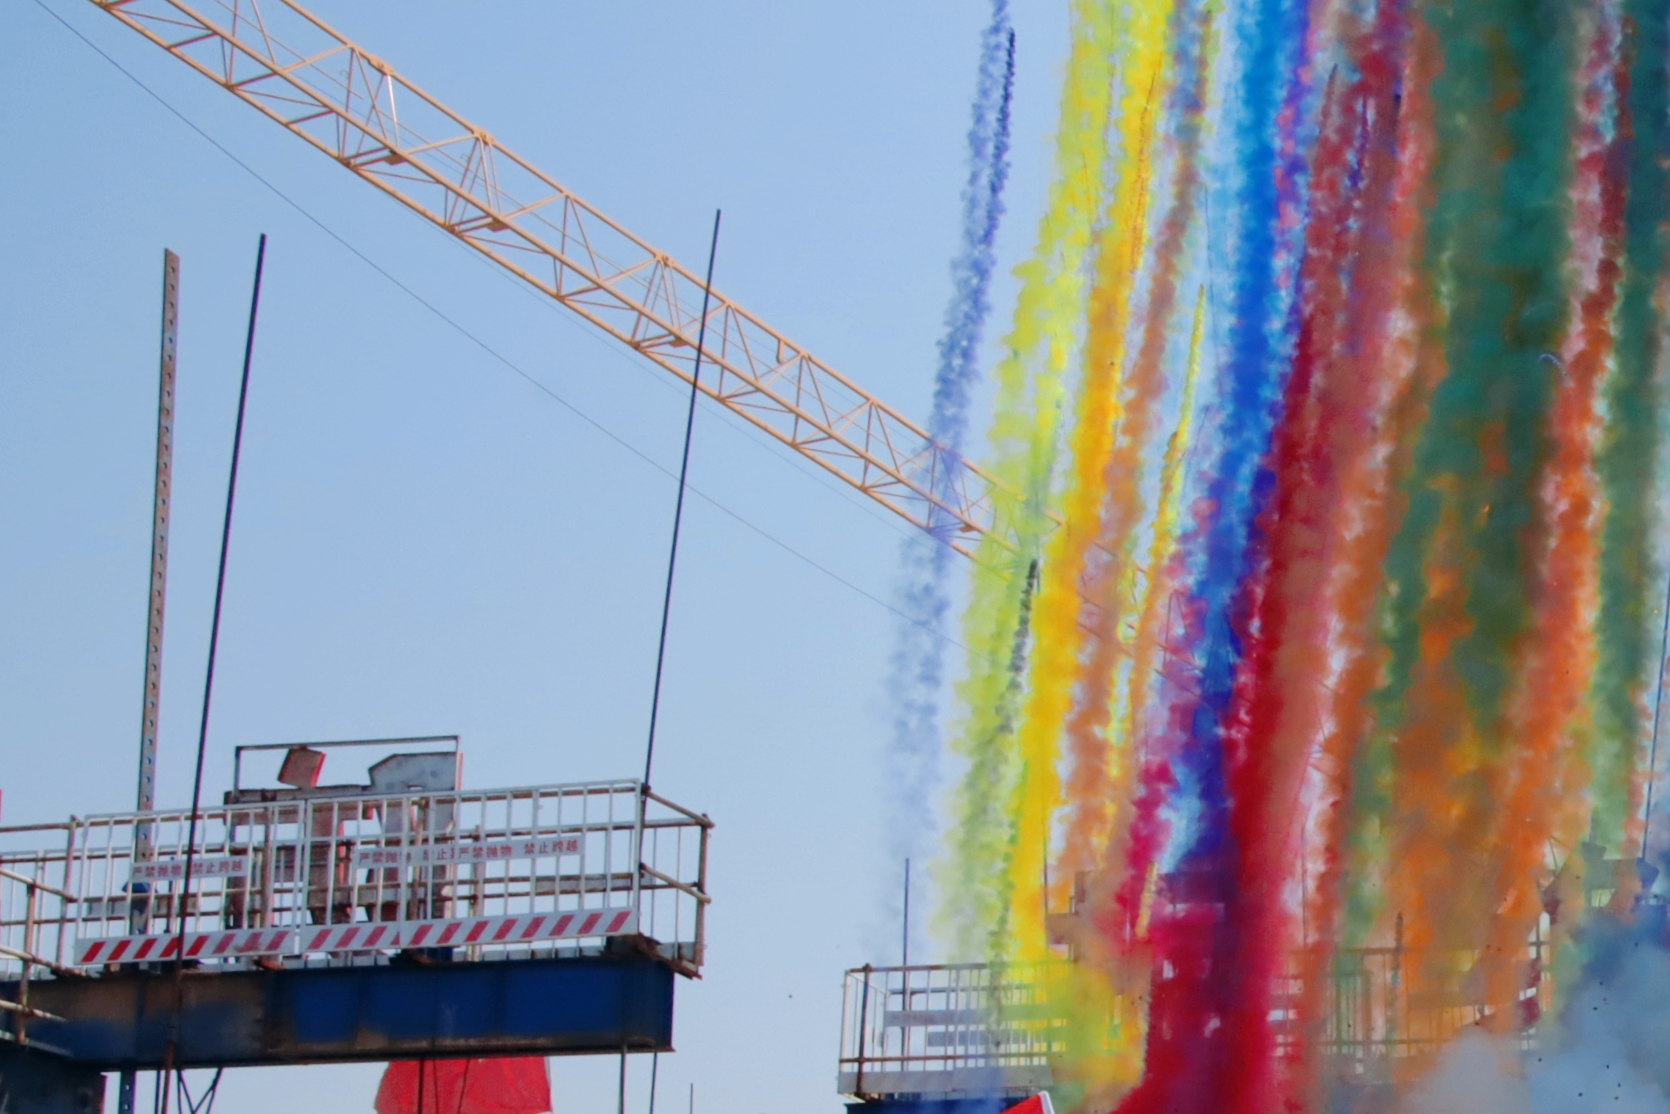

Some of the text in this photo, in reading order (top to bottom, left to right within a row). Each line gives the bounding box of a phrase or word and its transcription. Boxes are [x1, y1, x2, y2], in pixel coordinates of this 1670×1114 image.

[458, 845, 513, 859] 严禁抛物
[524, 839, 579, 854] 禁止跨越
[192, 859, 243, 876] 禁止跨越
